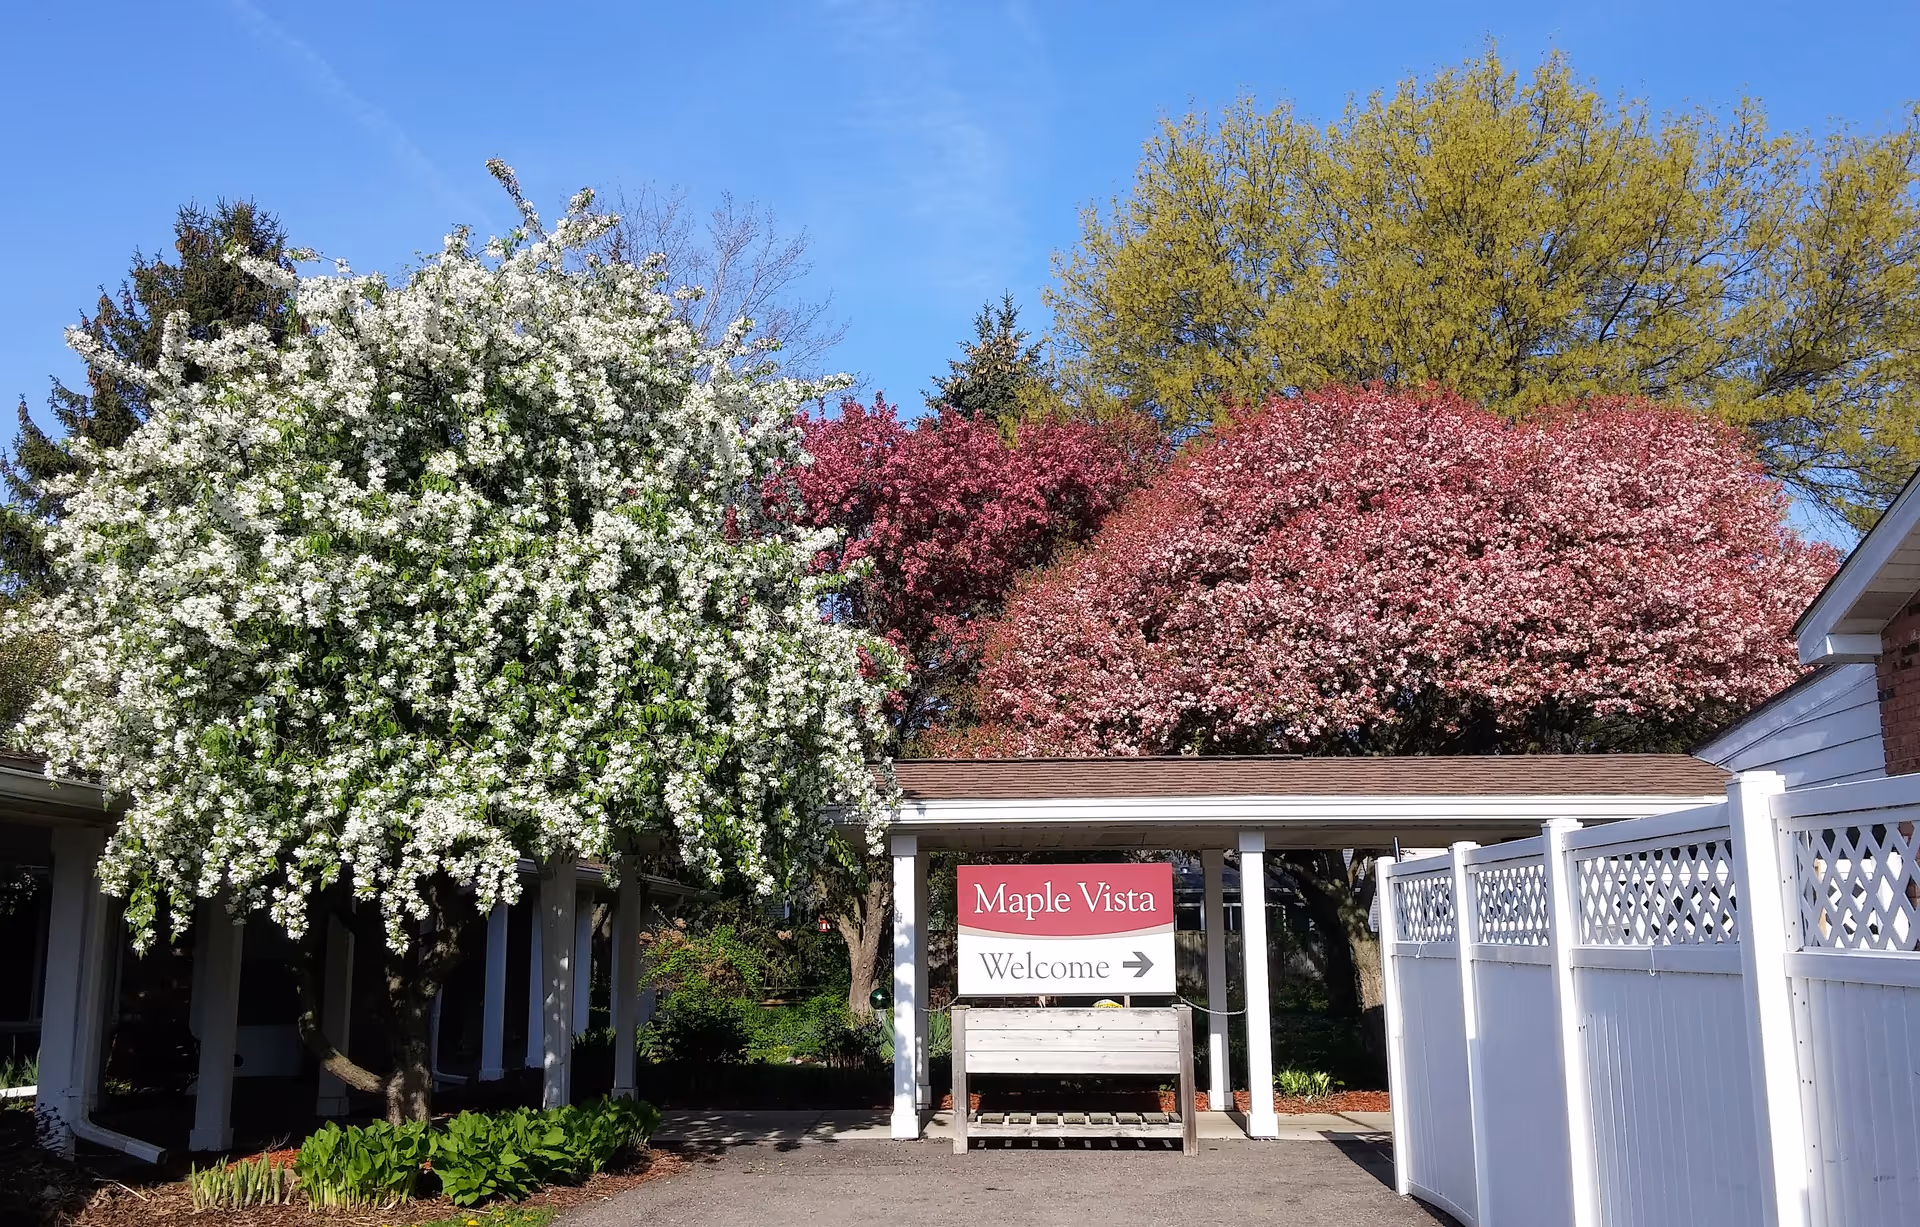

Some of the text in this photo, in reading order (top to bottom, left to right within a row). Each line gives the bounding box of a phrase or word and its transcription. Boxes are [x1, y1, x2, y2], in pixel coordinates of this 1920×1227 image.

[973, 881, 1157, 921] Maple Vista
[979, 951, 1110, 980] Welcome
